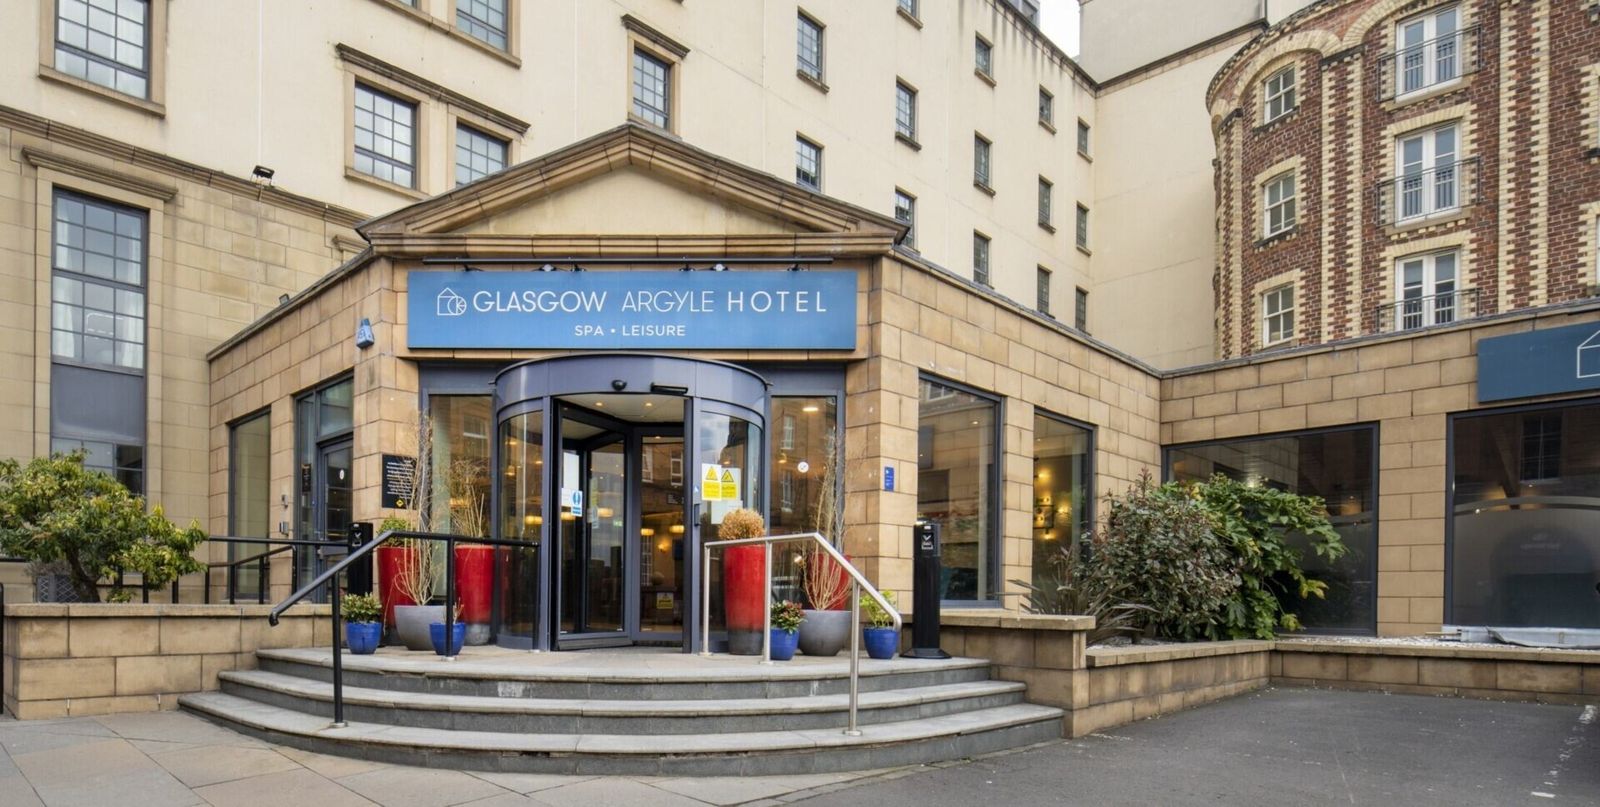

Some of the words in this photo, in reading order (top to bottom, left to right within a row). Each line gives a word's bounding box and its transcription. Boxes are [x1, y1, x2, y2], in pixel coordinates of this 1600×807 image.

[472, 290, 607, 313] GLASGOW
[621, 290, 715, 313] ARGYLE
[727, 290, 827, 313] HOTEL
[574, 325, 604, 337] SPA
[622, 325, 686, 337] LEISURE
